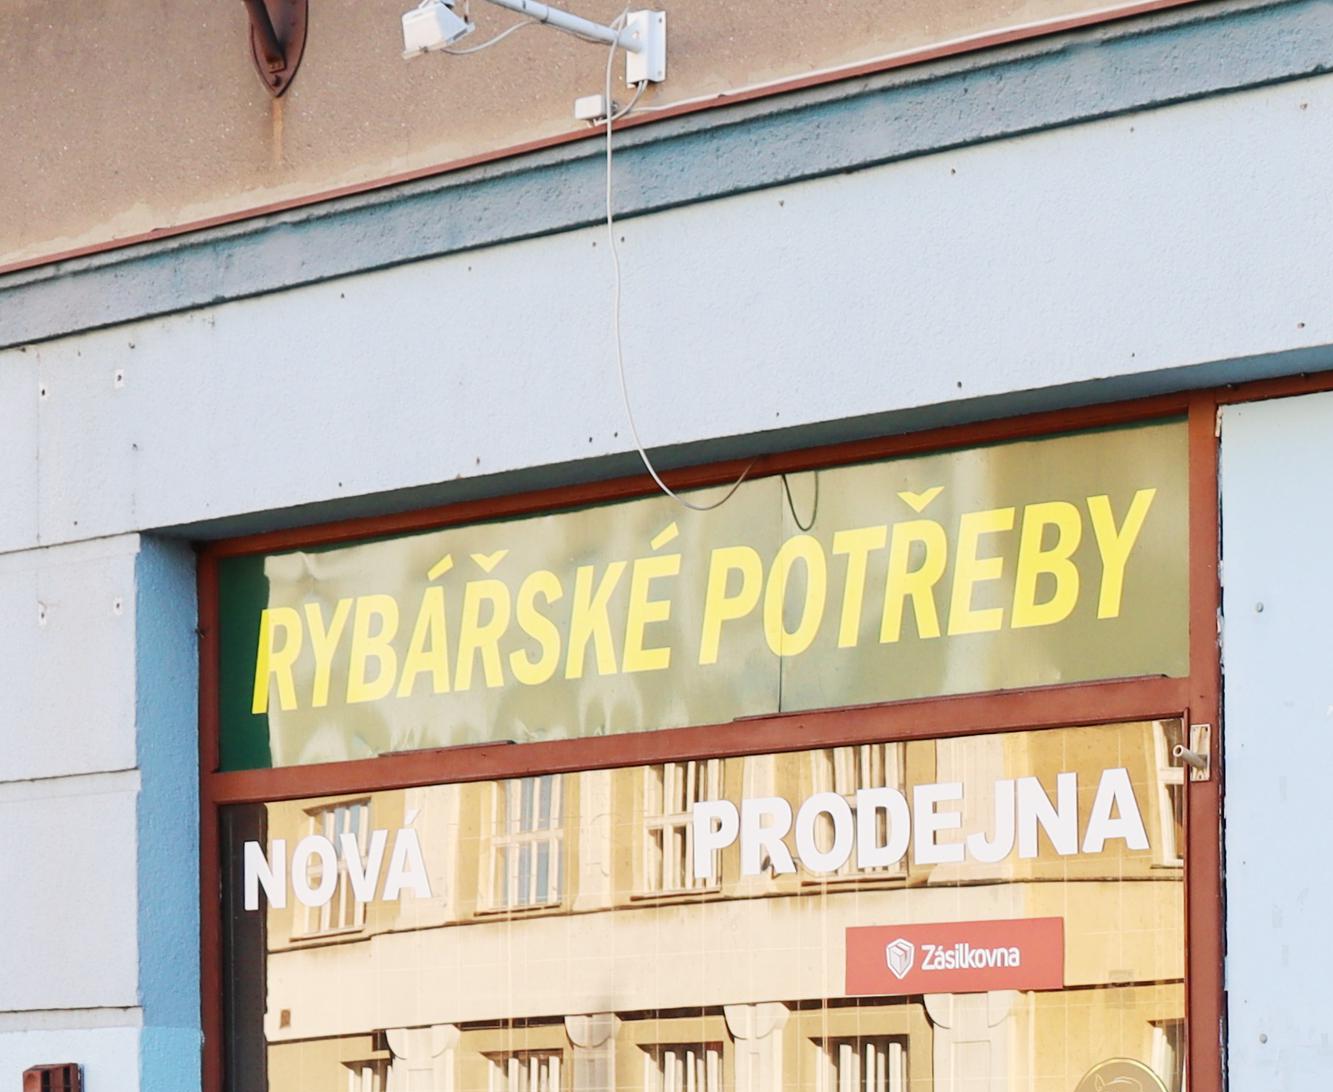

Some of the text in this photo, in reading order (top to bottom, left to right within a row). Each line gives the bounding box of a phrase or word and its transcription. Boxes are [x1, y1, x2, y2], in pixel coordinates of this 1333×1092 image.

[251, 484, 1157, 714] RYBÁŘSKÉ POTŘEBY
[243, 767, 1150, 911] NOVÁ PRODEJNA
[921, 942, 1021, 971] Zásilkovna
